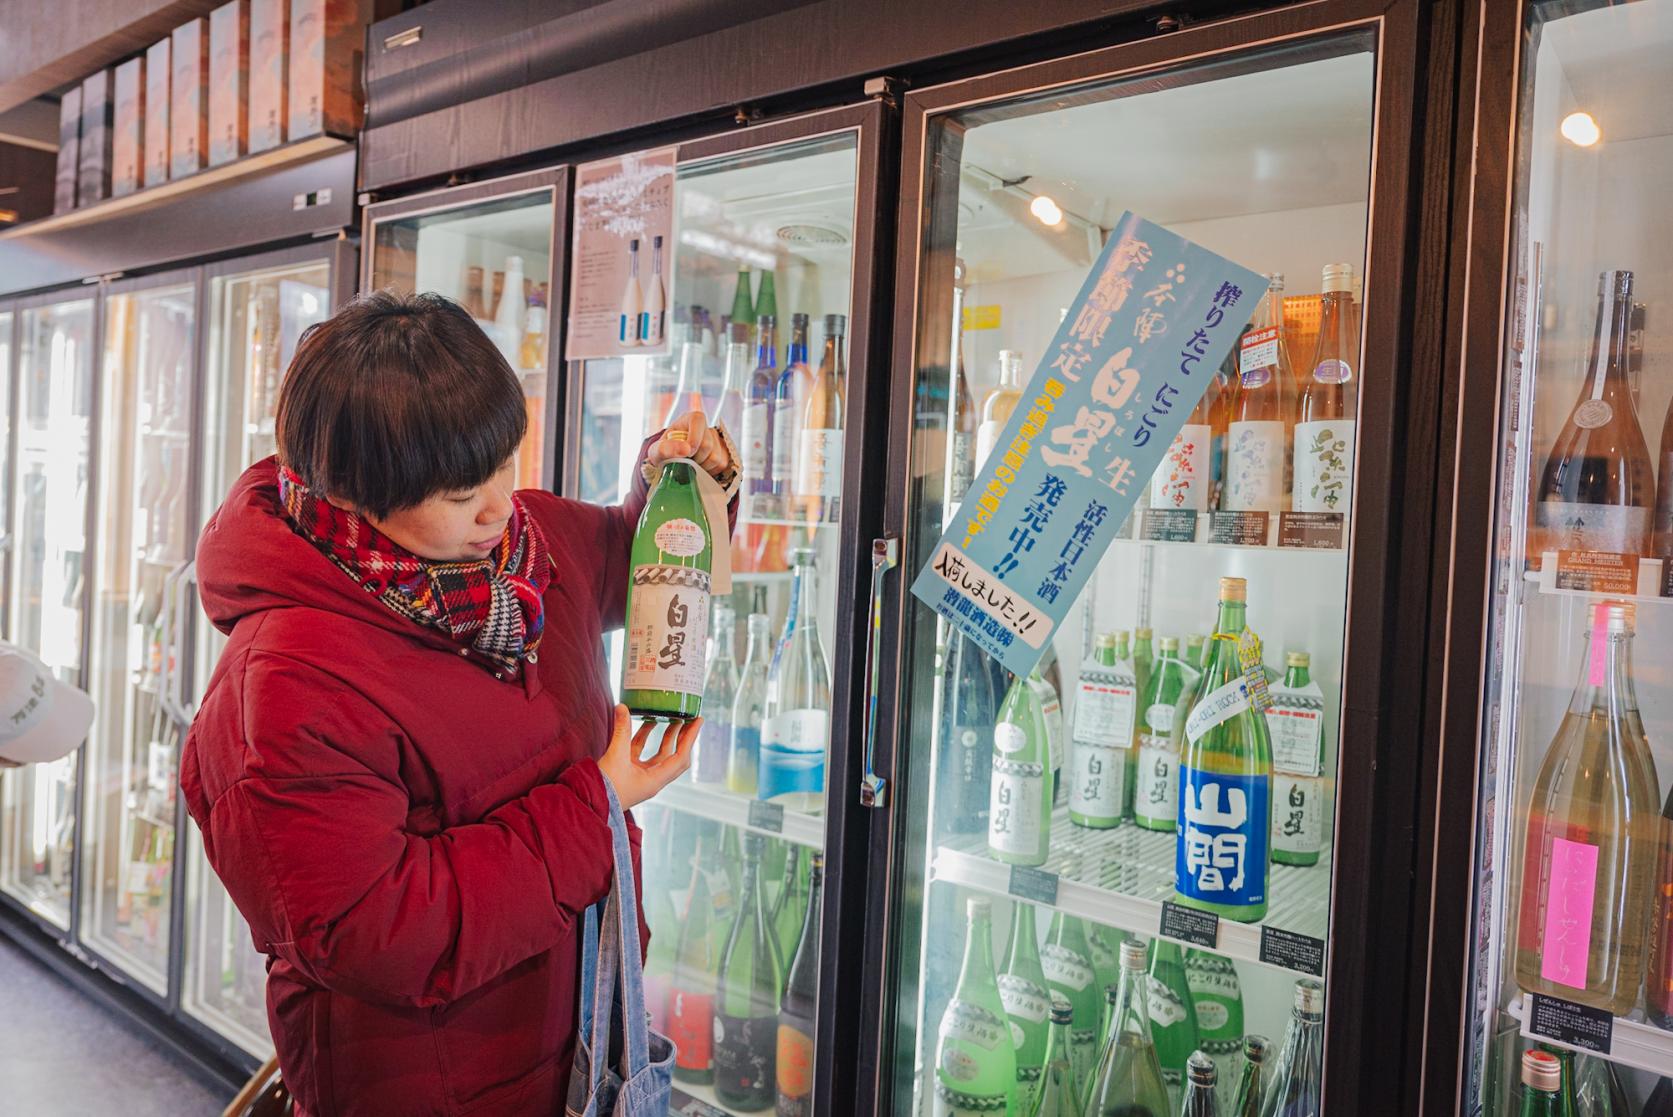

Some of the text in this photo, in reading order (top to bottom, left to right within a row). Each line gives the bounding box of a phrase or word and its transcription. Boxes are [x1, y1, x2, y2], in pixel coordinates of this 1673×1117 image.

[1049, 238, 1153, 382] 季節限定
[1179, 279, 1243, 377] 搾りたて
[1041, 346, 1142, 479] 白星
[1132, 383, 1183, 448] にごり
[1098, 455, 1138, 498] 生
[1036, 498, 1111, 605] 活性日本酒
[657, 593, 689, 670] 白星
[994, 780, 1011, 834] 白星
[1083, 753, 1102, 801] 白星
[1149, 755, 1169, 805] 白星
[1283, 783, 1305, 837] 白星
